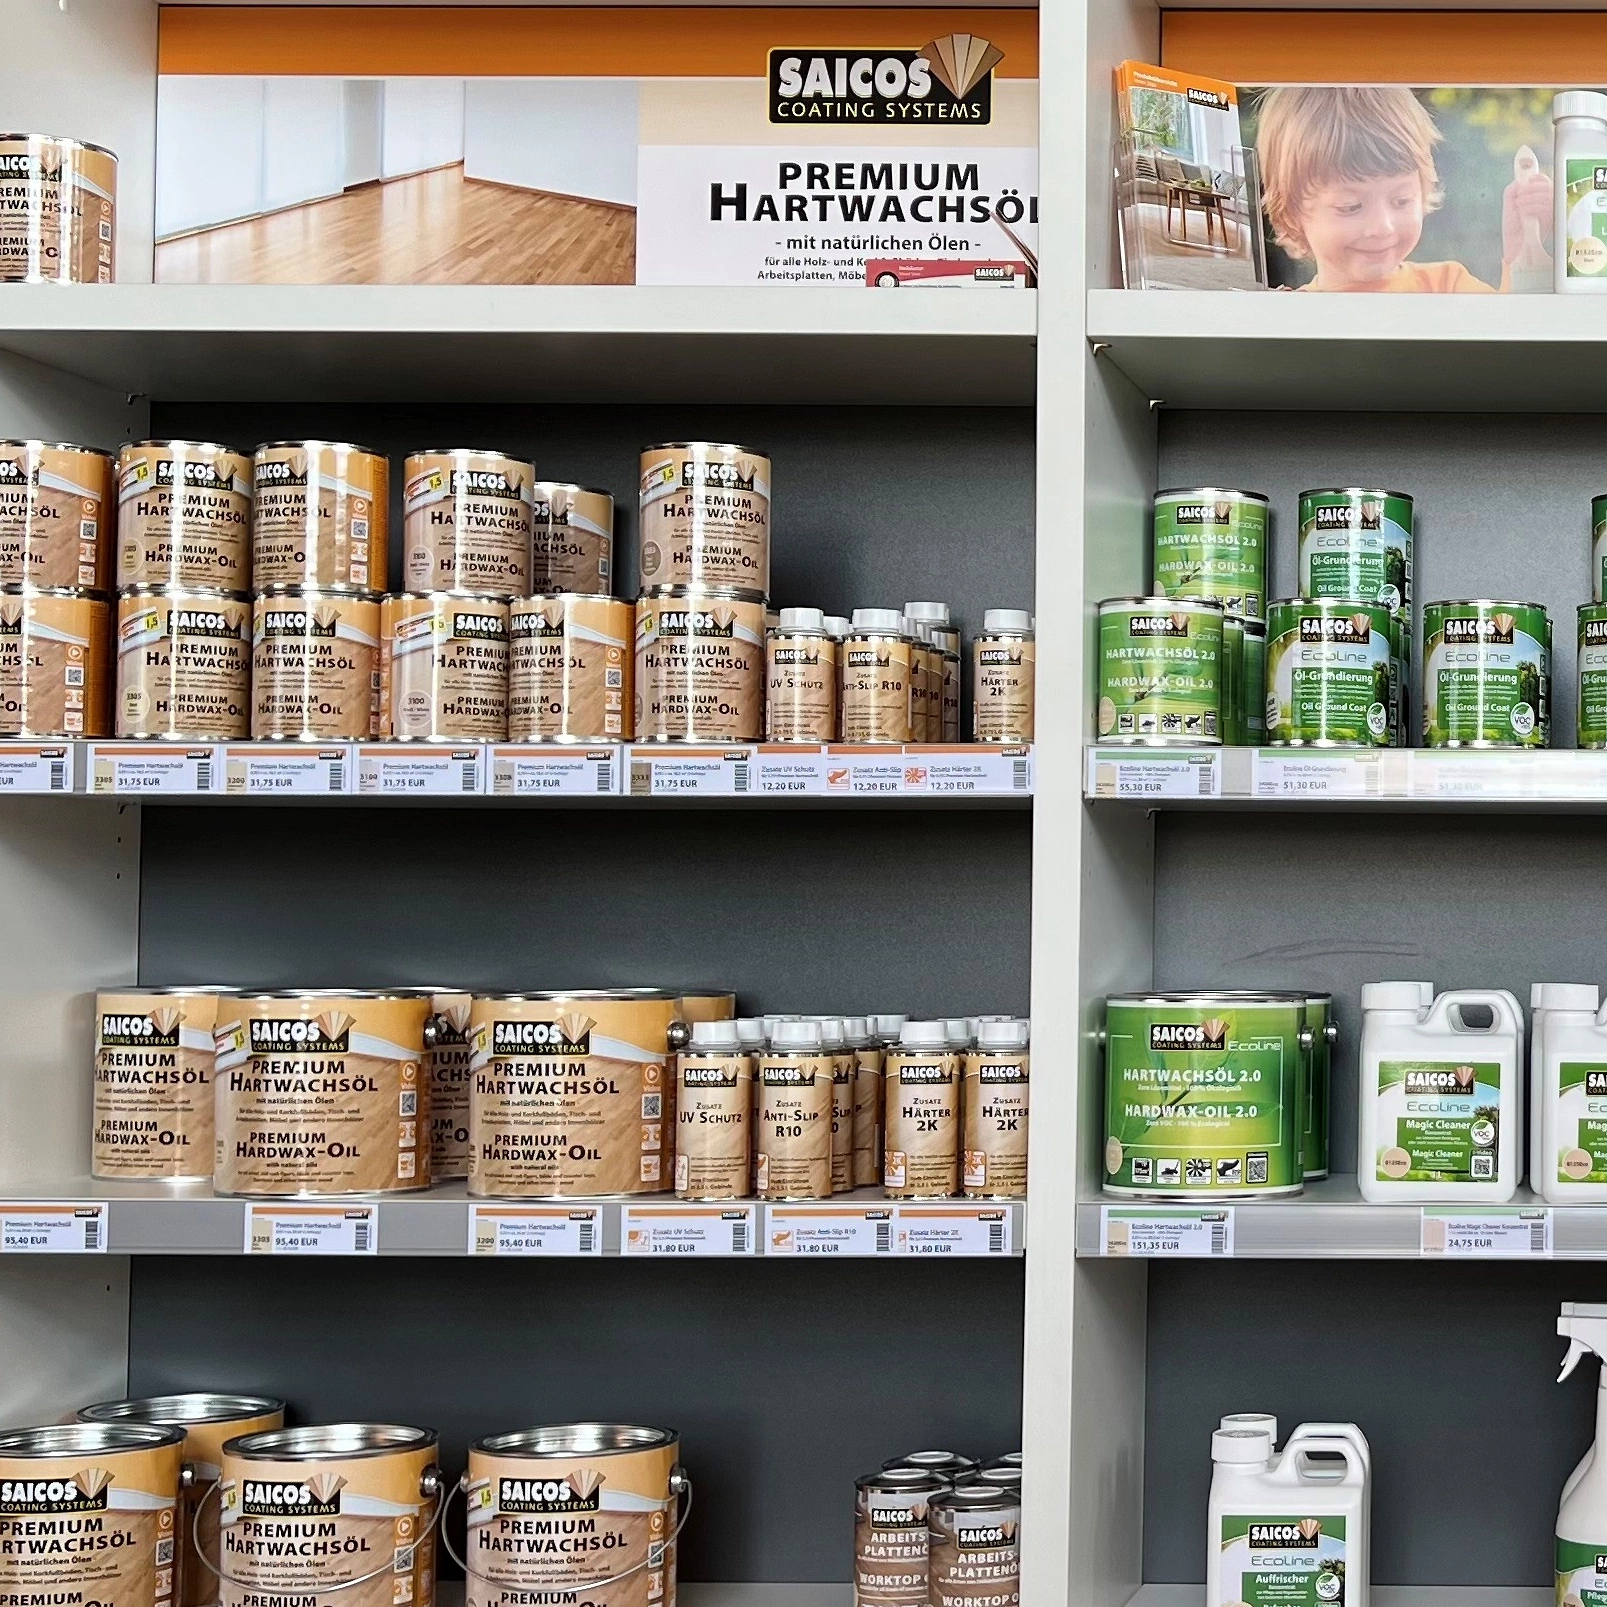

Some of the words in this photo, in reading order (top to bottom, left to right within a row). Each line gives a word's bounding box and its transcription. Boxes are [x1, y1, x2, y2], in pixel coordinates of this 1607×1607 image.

[778, 57, 931, 98] SAICOS
[777, 102, 876, 118] COATING
[885, 102, 981, 118] SYSTEMS
[778, 162, 979, 191] PREMIUM
[786, 236, 816, 251] mit
[821, 235, 923, 251] natürlichen
[928, 233, 970, 251] Ölen
[765, 257, 779, 267] für
[782, 257, 800, 266] alle
[831, 257, 855, 266] und
[1106, 646, 1198, 660] HARTWACHSÖL
[1200, 650, 1216, 660] 2.0
[881, 681, 902, 691] R10
[1199, 678, 1214, 689] 2.0
[990, 687, 1006, 697] 2K
[118, 778, 140, 787] 31,75
[143, 777, 161, 787] EUR
[251, 778, 273, 787] 31,75
[274, 778, 293, 787] EUR
[382, 779, 406, 788] 31,75
[407, 779, 426, 788] EUR
[517, 779, 541, 788] 31,75
[542, 779, 561, 788] EUR
[654, 779, 678, 788] 31,75
[680, 779, 697, 788] EUR
[762, 781, 786, 791] 12,20
[788, 781, 806, 791] EUR
[853, 782, 878, 792] 12,20
[879, 782, 898, 791] EUR
[930, 781, 955, 791] 12,20
[956, 781, 975, 791] EUR
[1119, 782, 1143, 792] 55,30
[1145, 782, 1162, 792] EUR
[1283, 781, 1307, 791] 51,30
[1309, 781, 1327, 790] EUR
[251, 1022, 320, 1042] SAICOS
[495, 1023, 564, 1044] SAICOS
[1152, 1026, 1205, 1042] SAICOS
[495, 1044, 534, 1054] COATING
[537, 1044, 586, 1054] SYSTEMS
[101, 1053, 176, 1067] PREMIUM
[251, 1060, 345, 1075] PREMIUM
[493, 1062, 586, 1077] PREMIUM
[1124, 1067, 1236, 1082] HARTWACHSÖL
[1239, 1070, 1261, 1082] 2.0
[230, 1075, 379, 1093] HARTWACHSÖL
[476, 1073, 620, 1095] HARTWACHSÖL
[1125, 1104, 1231, 1118] HARDWAX-OIL
[1235, 1105, 1258, 1117] 2.0
[1407, 1101, 1470, 1112] EcoLine
[679, 1111, 694, 1124] UV
[699, 1111, 743, 1124] SCHUTZ
[775, 1125, 802, 1137] R10
[916, 1119, 938, 1132] 2K
[996, 1119, 1018, 1131] 2K
[1406, 1119, 1434, 1131] Magic
[1436, 1119, 1471, 1129] Cleaner
[249, 1131, 326, 1144] PREMIUM
[494, 1134, 567, 1147] PREMIUM
[235, 1141, 361, 1159] HARDWAX-OIL
[482, 1144, 602, 1162] HARDWAX-OIL
[244, 1483, 311, 1506] SAICOS
[502, 1481, 571, 1501] SAICOS
[501, 1501, 544, 1511] COATING
[547, 1500, 595, 1510] SYSTEMS
[873, 1509, 913, 1522] SAICOS
[242, 1523, 337, 1539] PREMIUM
[500, 1519, 595, 1534] PREMIUM
[1252, 1526, 1300, 1540] SAICOS
[479, 1529, 628, 1552] HARTWACHSÖL
[1252, 1555, 1315, 1566] EcoLine
[1255, 1574, 1309, 1584] Auffrischer
